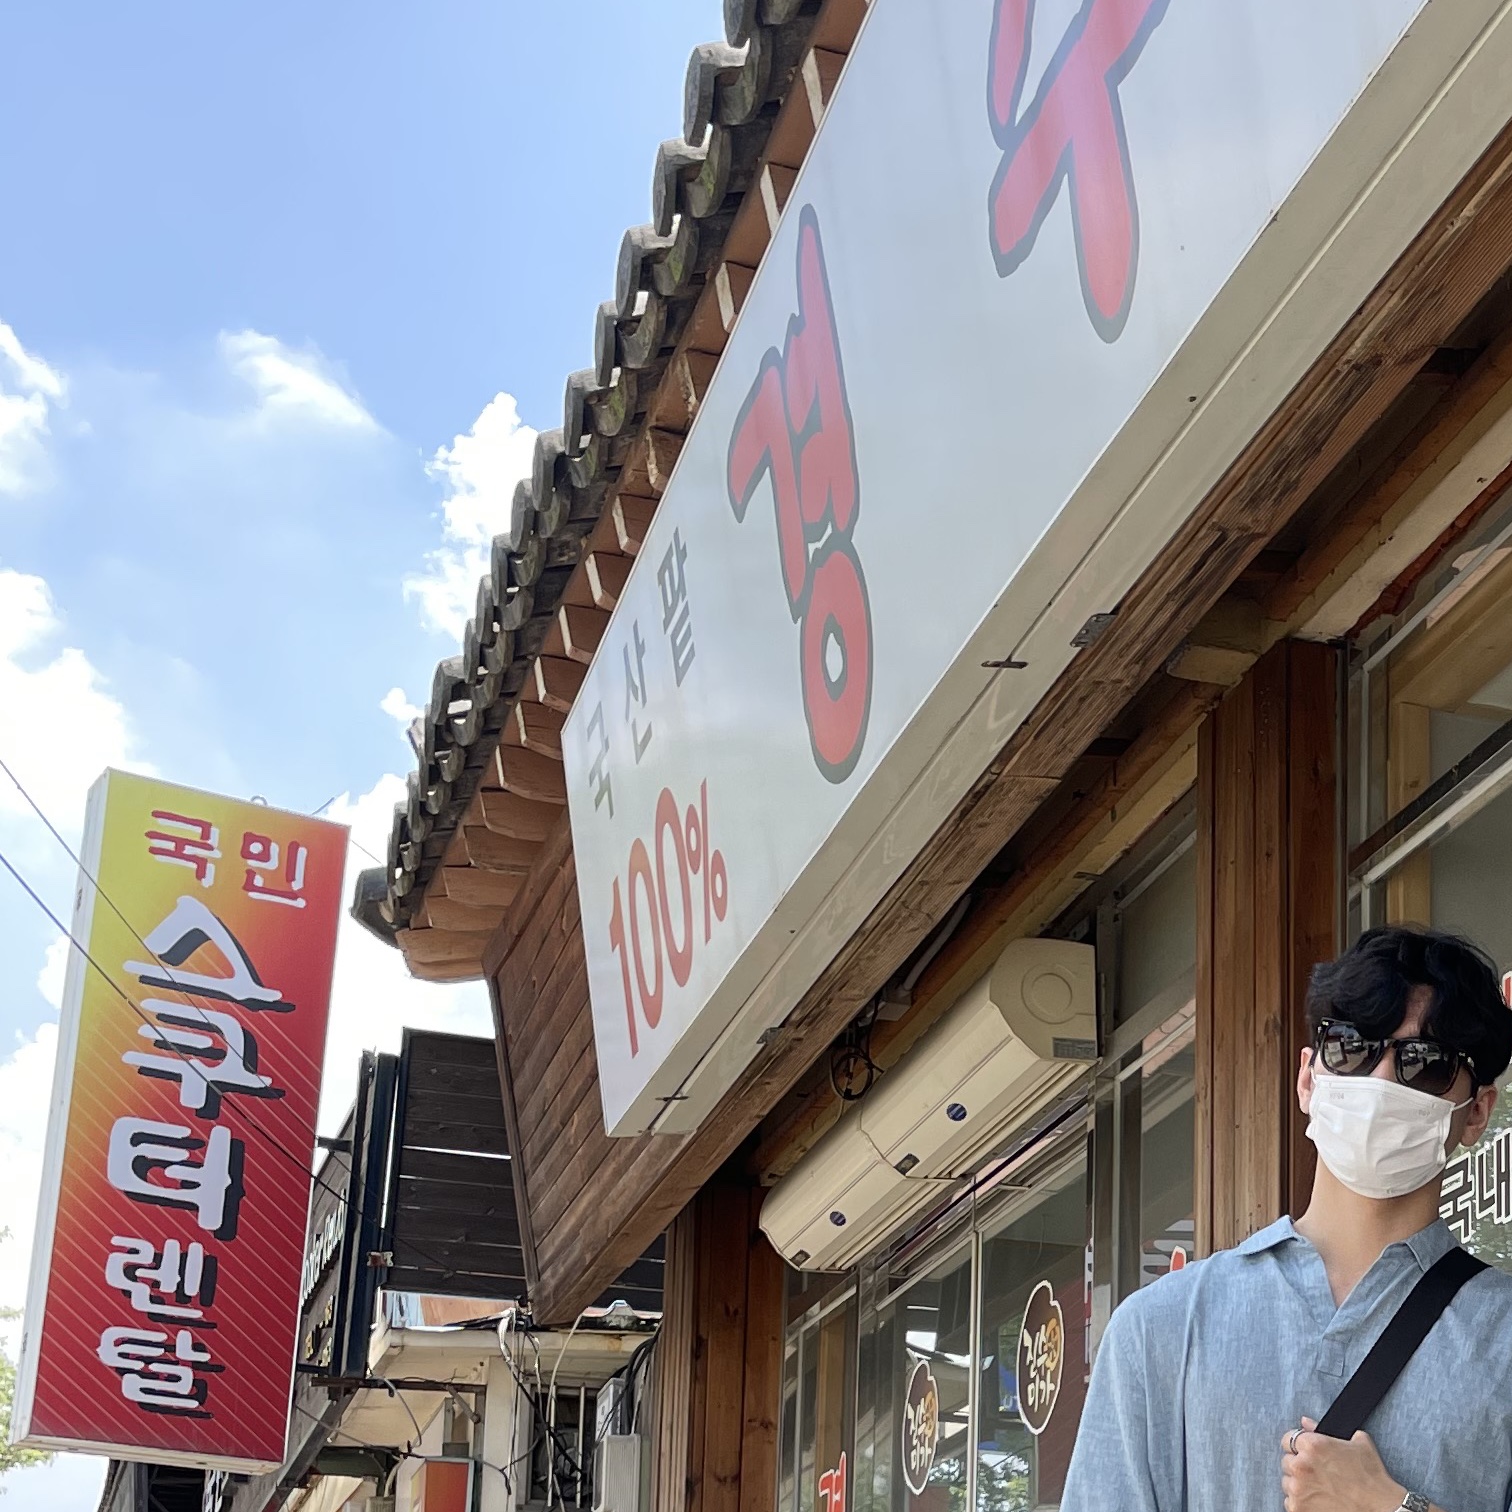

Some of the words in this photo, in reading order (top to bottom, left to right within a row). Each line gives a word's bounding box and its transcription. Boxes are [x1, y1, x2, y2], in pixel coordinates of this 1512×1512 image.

[145, 811, 307, 908] 국민
[609, 777, 728, 1058] 100%
[106, 895, 292, 1238] 스쿠터
[97, 1236, 222, 1414] 렌탈
